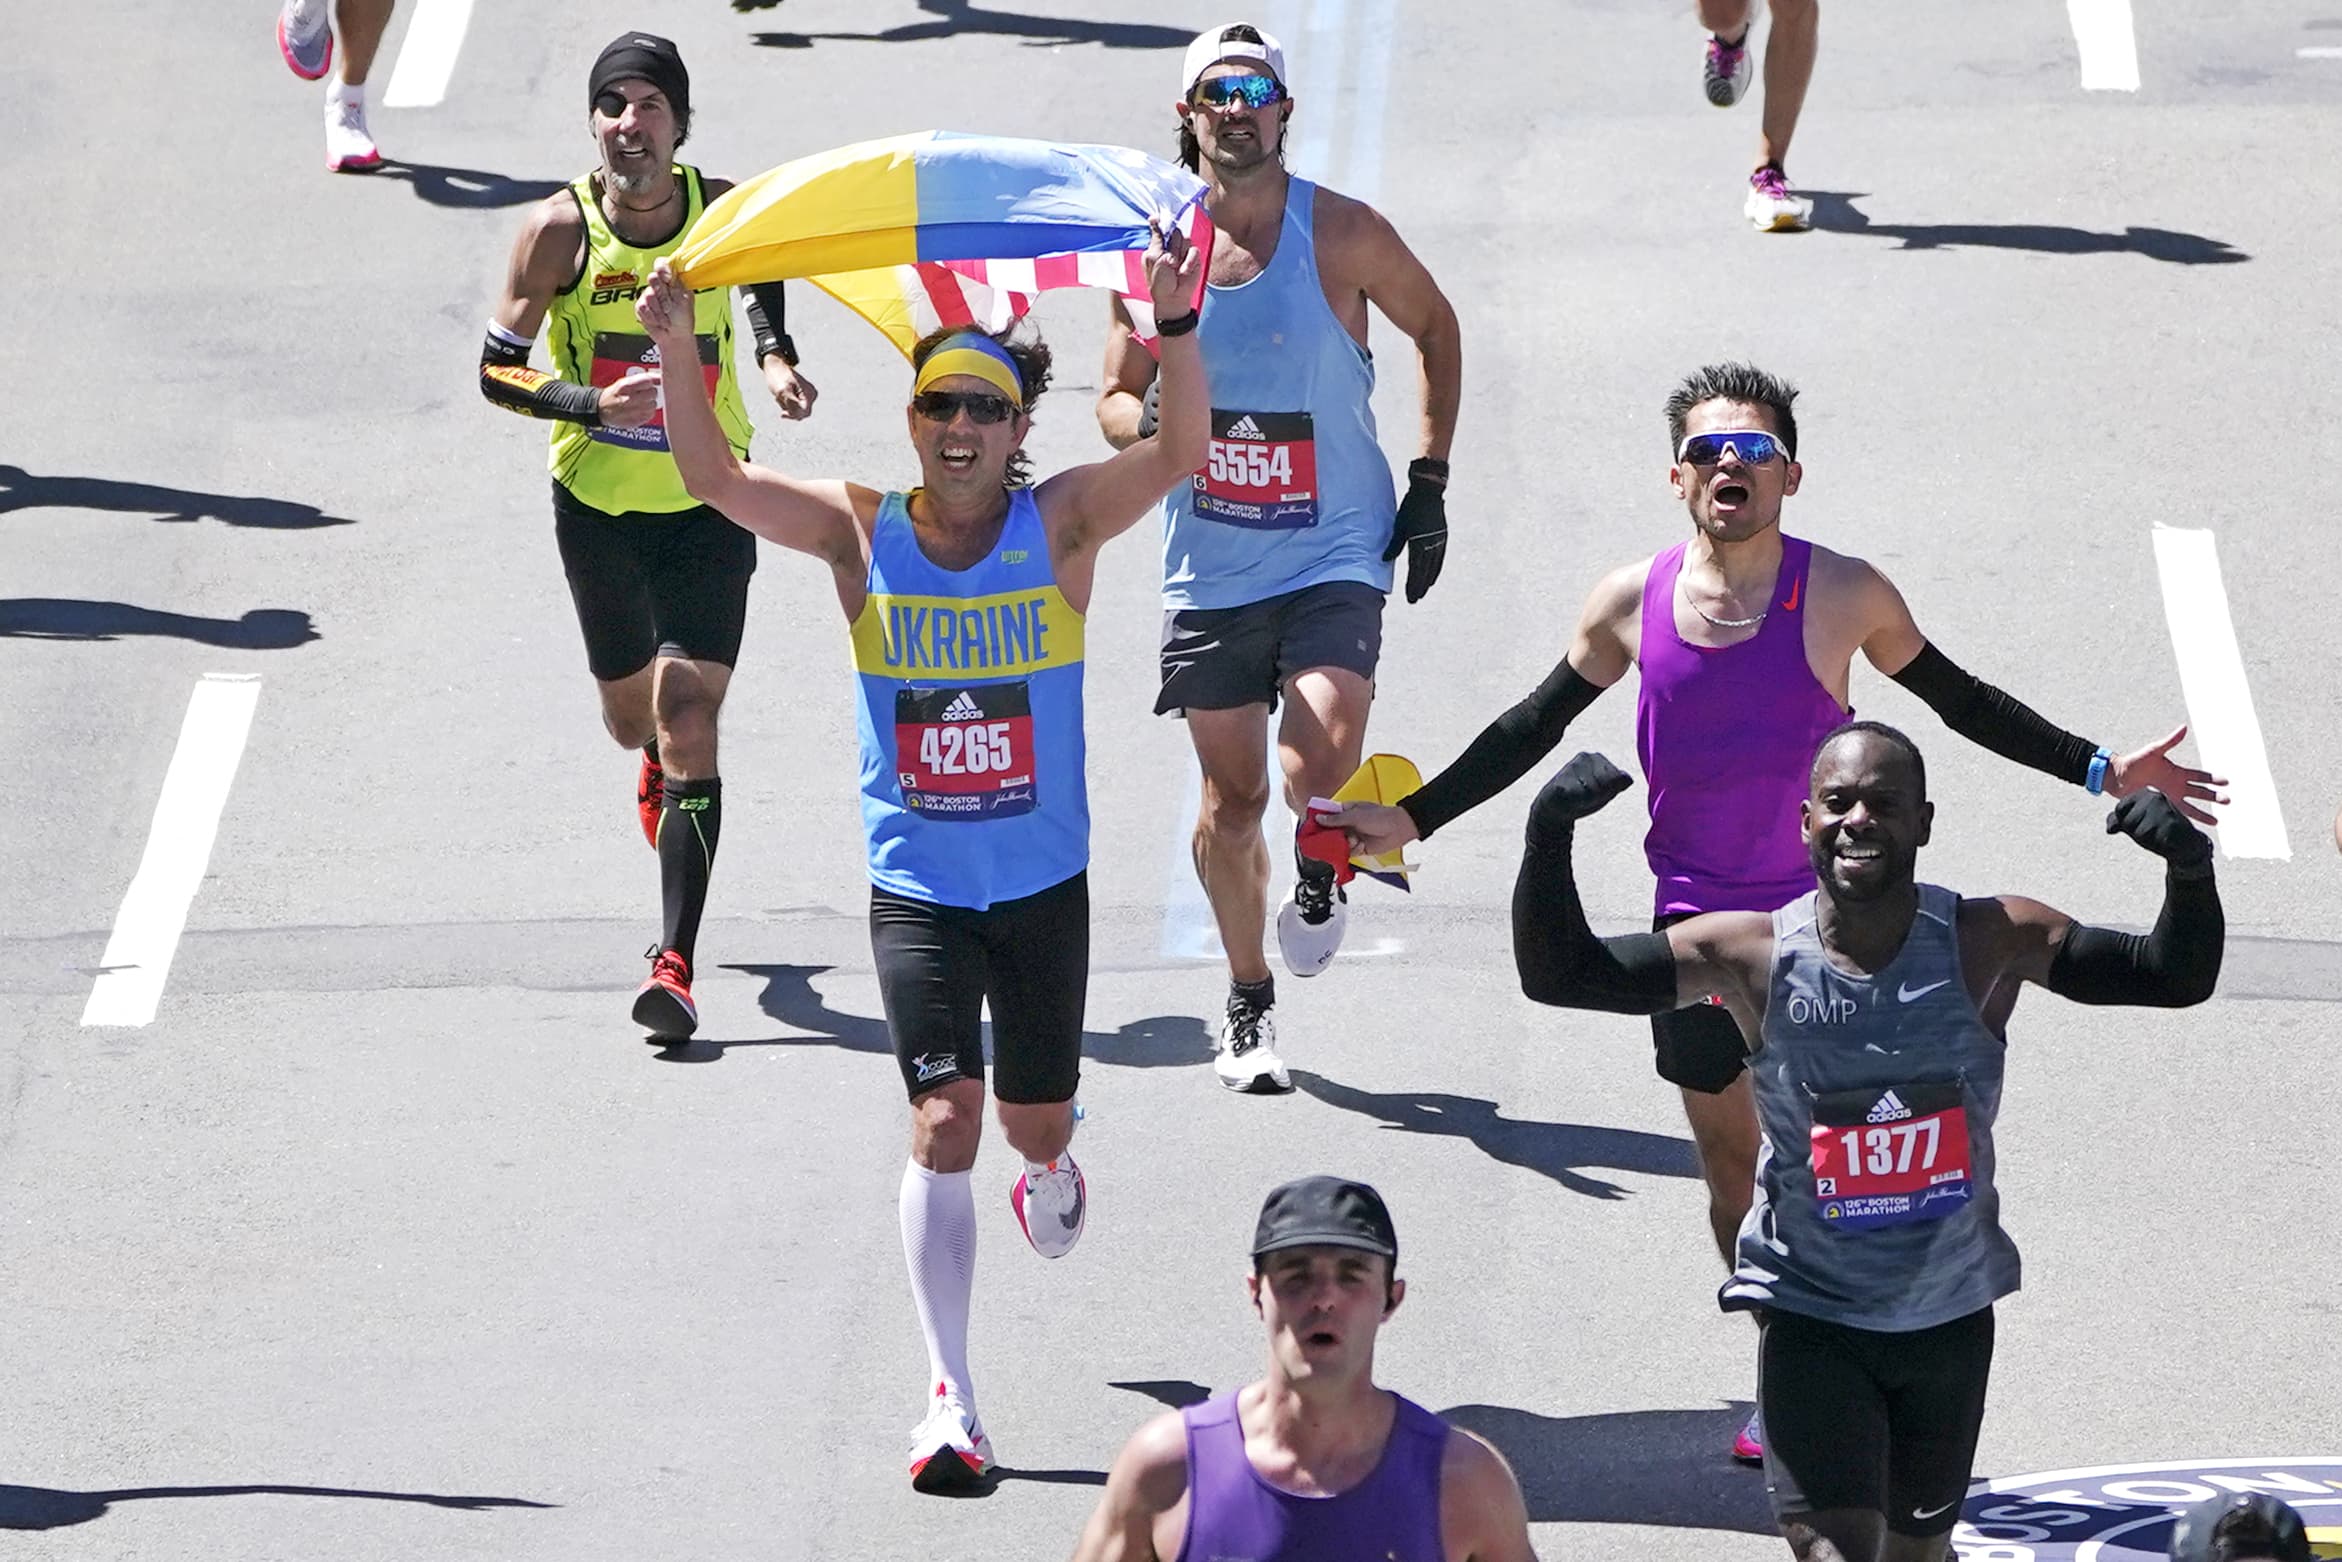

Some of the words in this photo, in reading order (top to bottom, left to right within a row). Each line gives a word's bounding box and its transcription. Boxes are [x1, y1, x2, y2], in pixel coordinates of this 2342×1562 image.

[607, 427, 662, 443] MARATHON
[1226, 430, 1266, 441] adidas
[1208, 440, 1293, 488] 5554
[1196, 477, 1205, 489] 6
[1212, 505, 1262, 520] MARATHON
[1228, 503, 1261, 513] BOSTON
[884, 598, 1049, 669] UKRAINE
[941, 709, 984, 721] adidas
[920, 722, 1012, 775] 4265
[903, 775, 914, 786] 5
[943, 795, 980, 805] BOSTON
[924, 803, 981, 812] MARATHON
[1788, 997, 1858, 1025] OMP
[1866, 1108, 1912, 1123] adidas
[1840, 1117, 1941, 1176] 1377
[1820, 1179, 1833, 1195] 2
[1868, 1195, 1909, 1207] BOSTON
[1845, 1204, 1910, 1217] MARATHON
